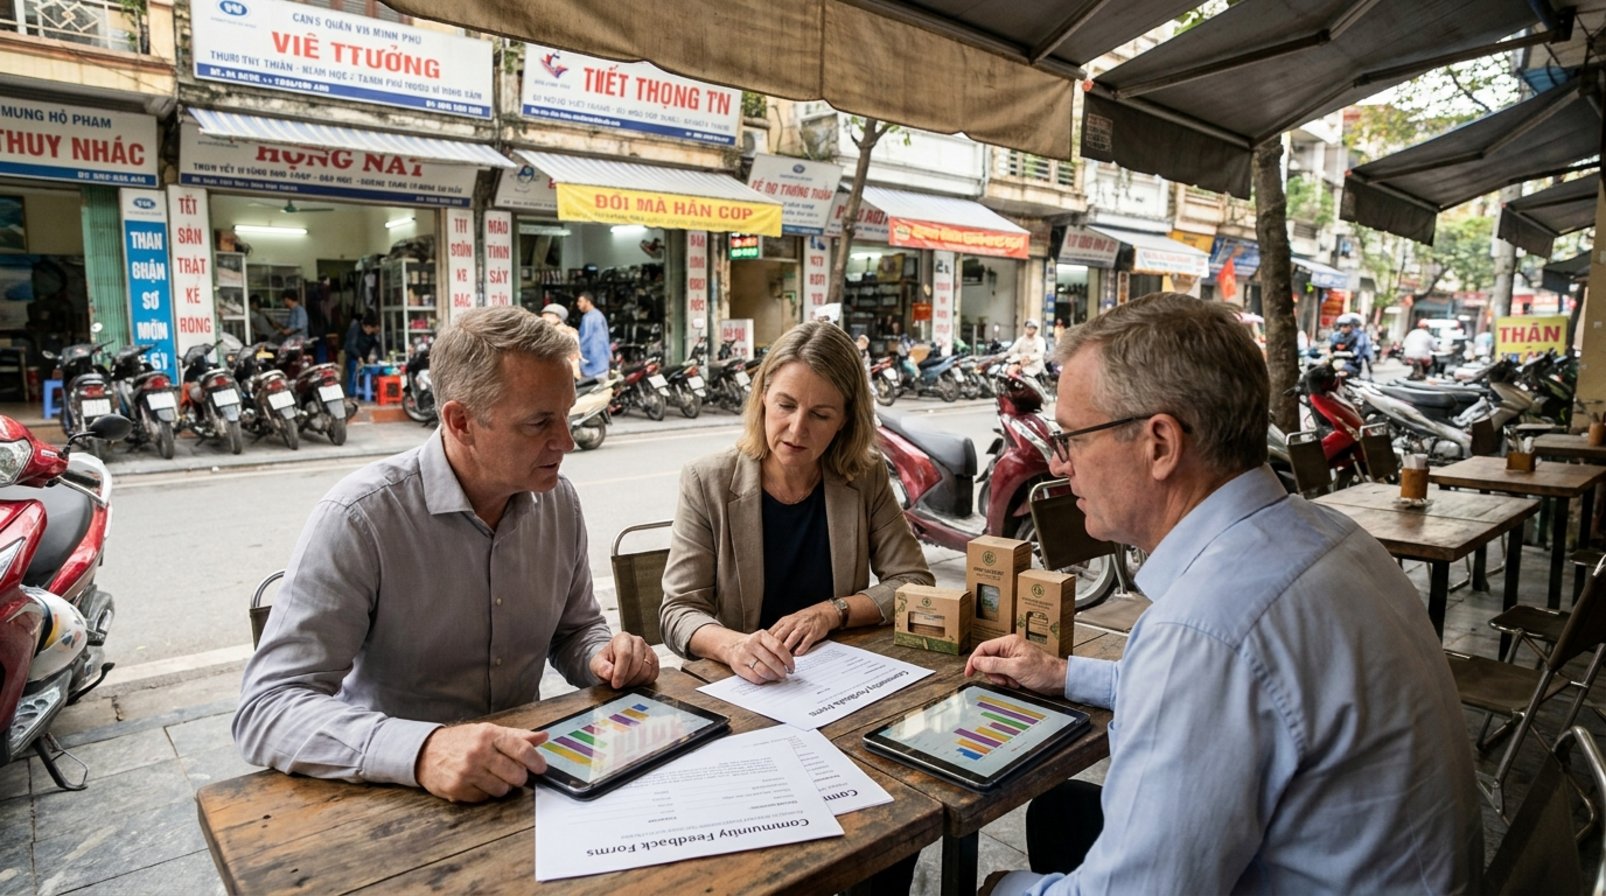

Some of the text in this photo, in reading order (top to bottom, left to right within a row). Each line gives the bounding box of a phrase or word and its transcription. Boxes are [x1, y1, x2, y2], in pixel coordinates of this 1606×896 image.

[1, 105, 44, 121] MUNG
[641, 831, 715, 851] Feedback
[586, 843, 637, 858] Forms
